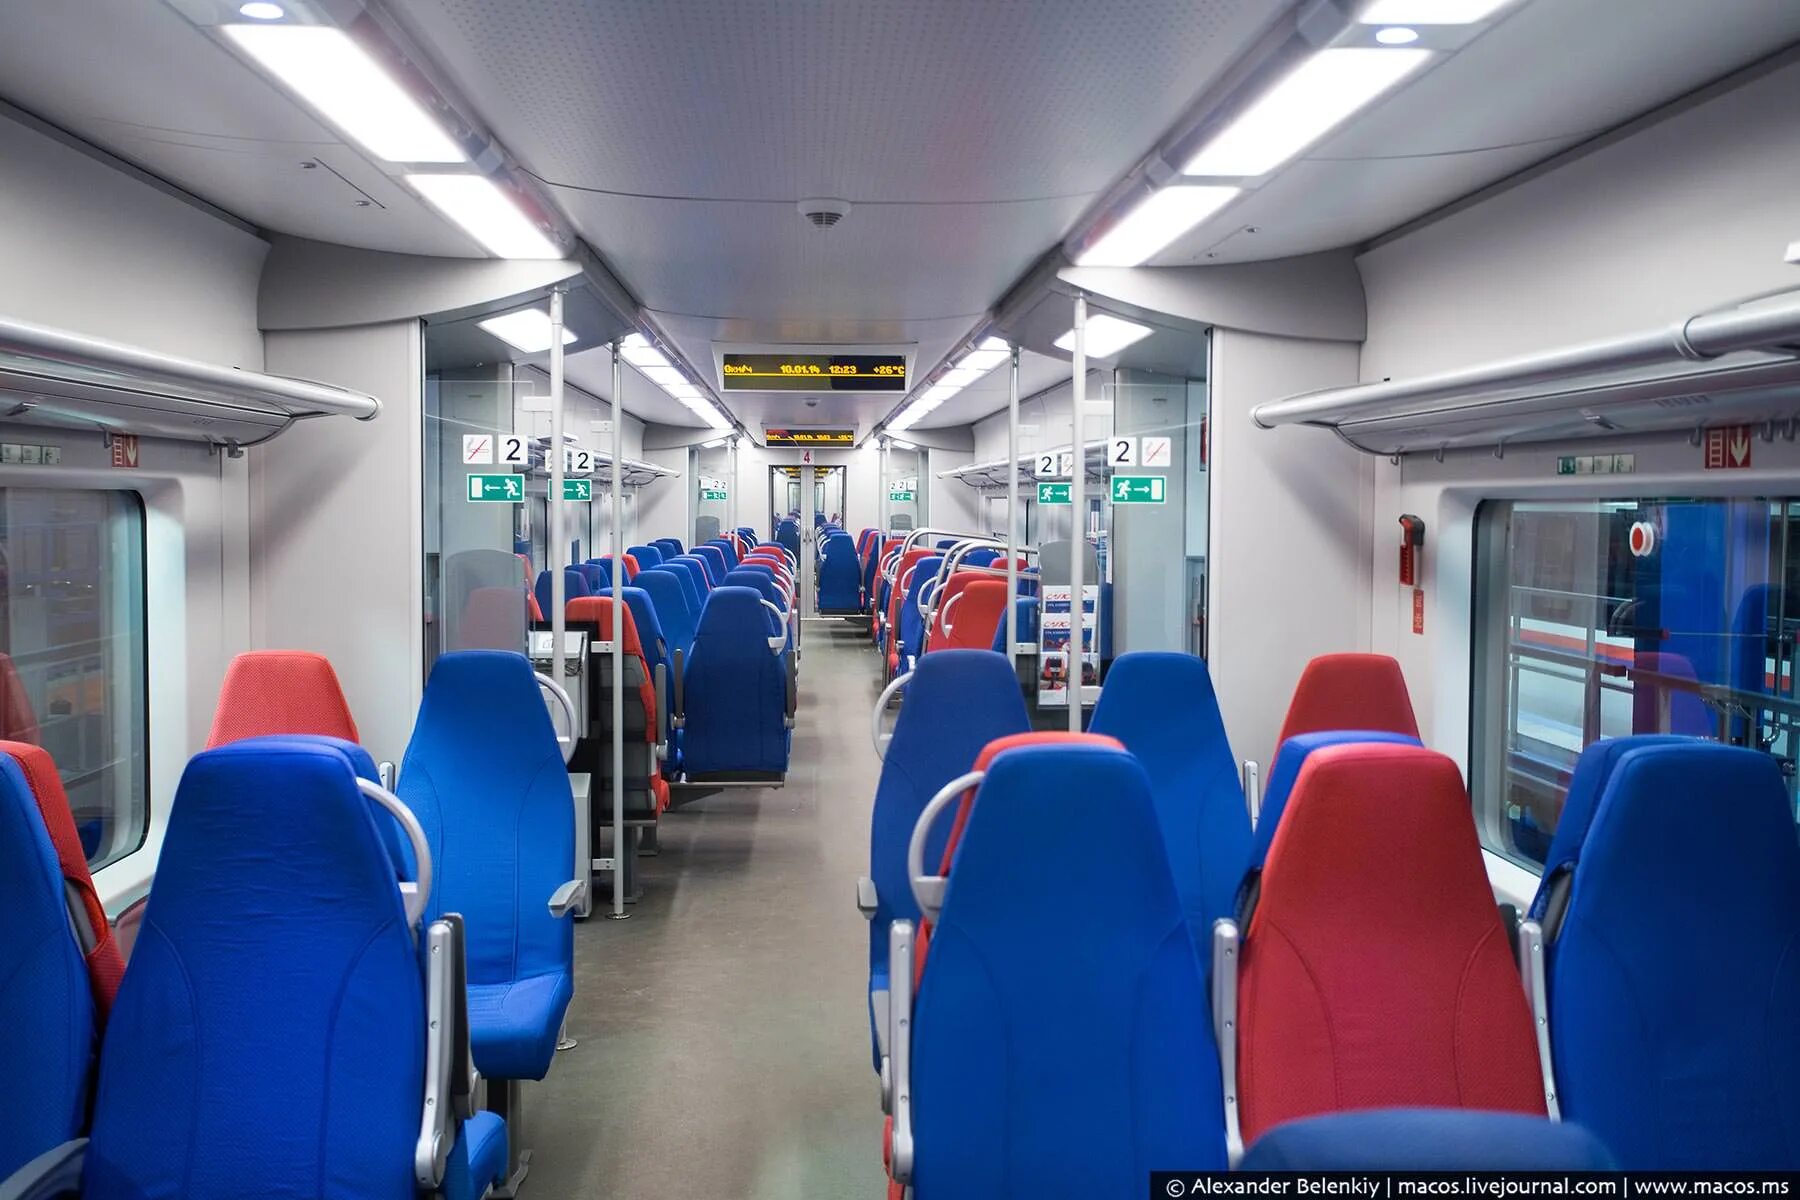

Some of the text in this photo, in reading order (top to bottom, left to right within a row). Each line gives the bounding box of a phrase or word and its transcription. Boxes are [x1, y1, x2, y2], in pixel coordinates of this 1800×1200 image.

[780, 364, 820, 374] 10.01.14
[829, 365, 857, 374] 12:23
[505, 438, 521, 461] 2
[803, 450, 811, 463] 4
[1115, 440, 1130, 462] 2
[577, 452, 589, 470] 2
[1041, 456, 1052, 473] 2
